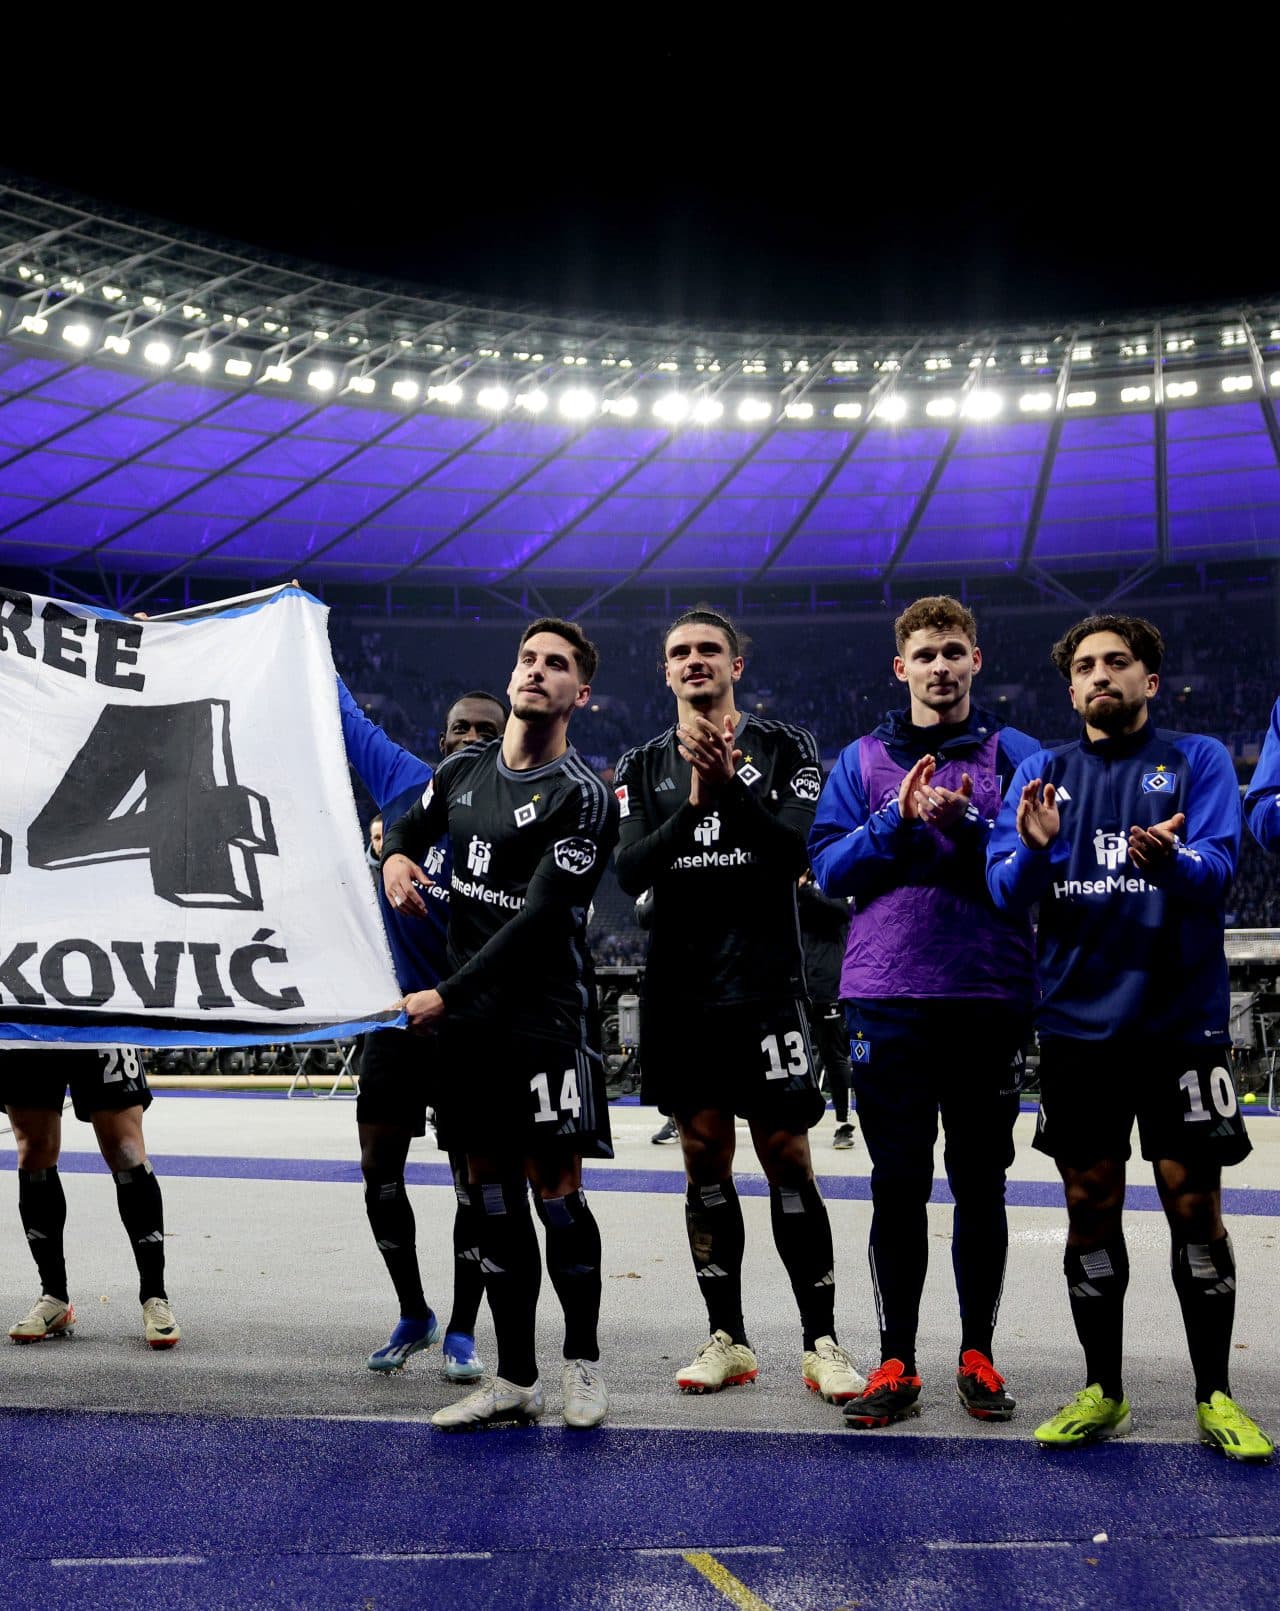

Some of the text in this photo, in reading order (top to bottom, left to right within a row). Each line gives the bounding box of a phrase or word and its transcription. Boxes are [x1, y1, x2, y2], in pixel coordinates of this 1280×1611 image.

[1053, 875, 1158, 899] HnseMer
[98, 1048, 140, 1084] 28
[761, 1030, 809, 1080] 13
[530, 1069, 581, 1123] 14
[1178, 1066, 1238, 1122] 10
